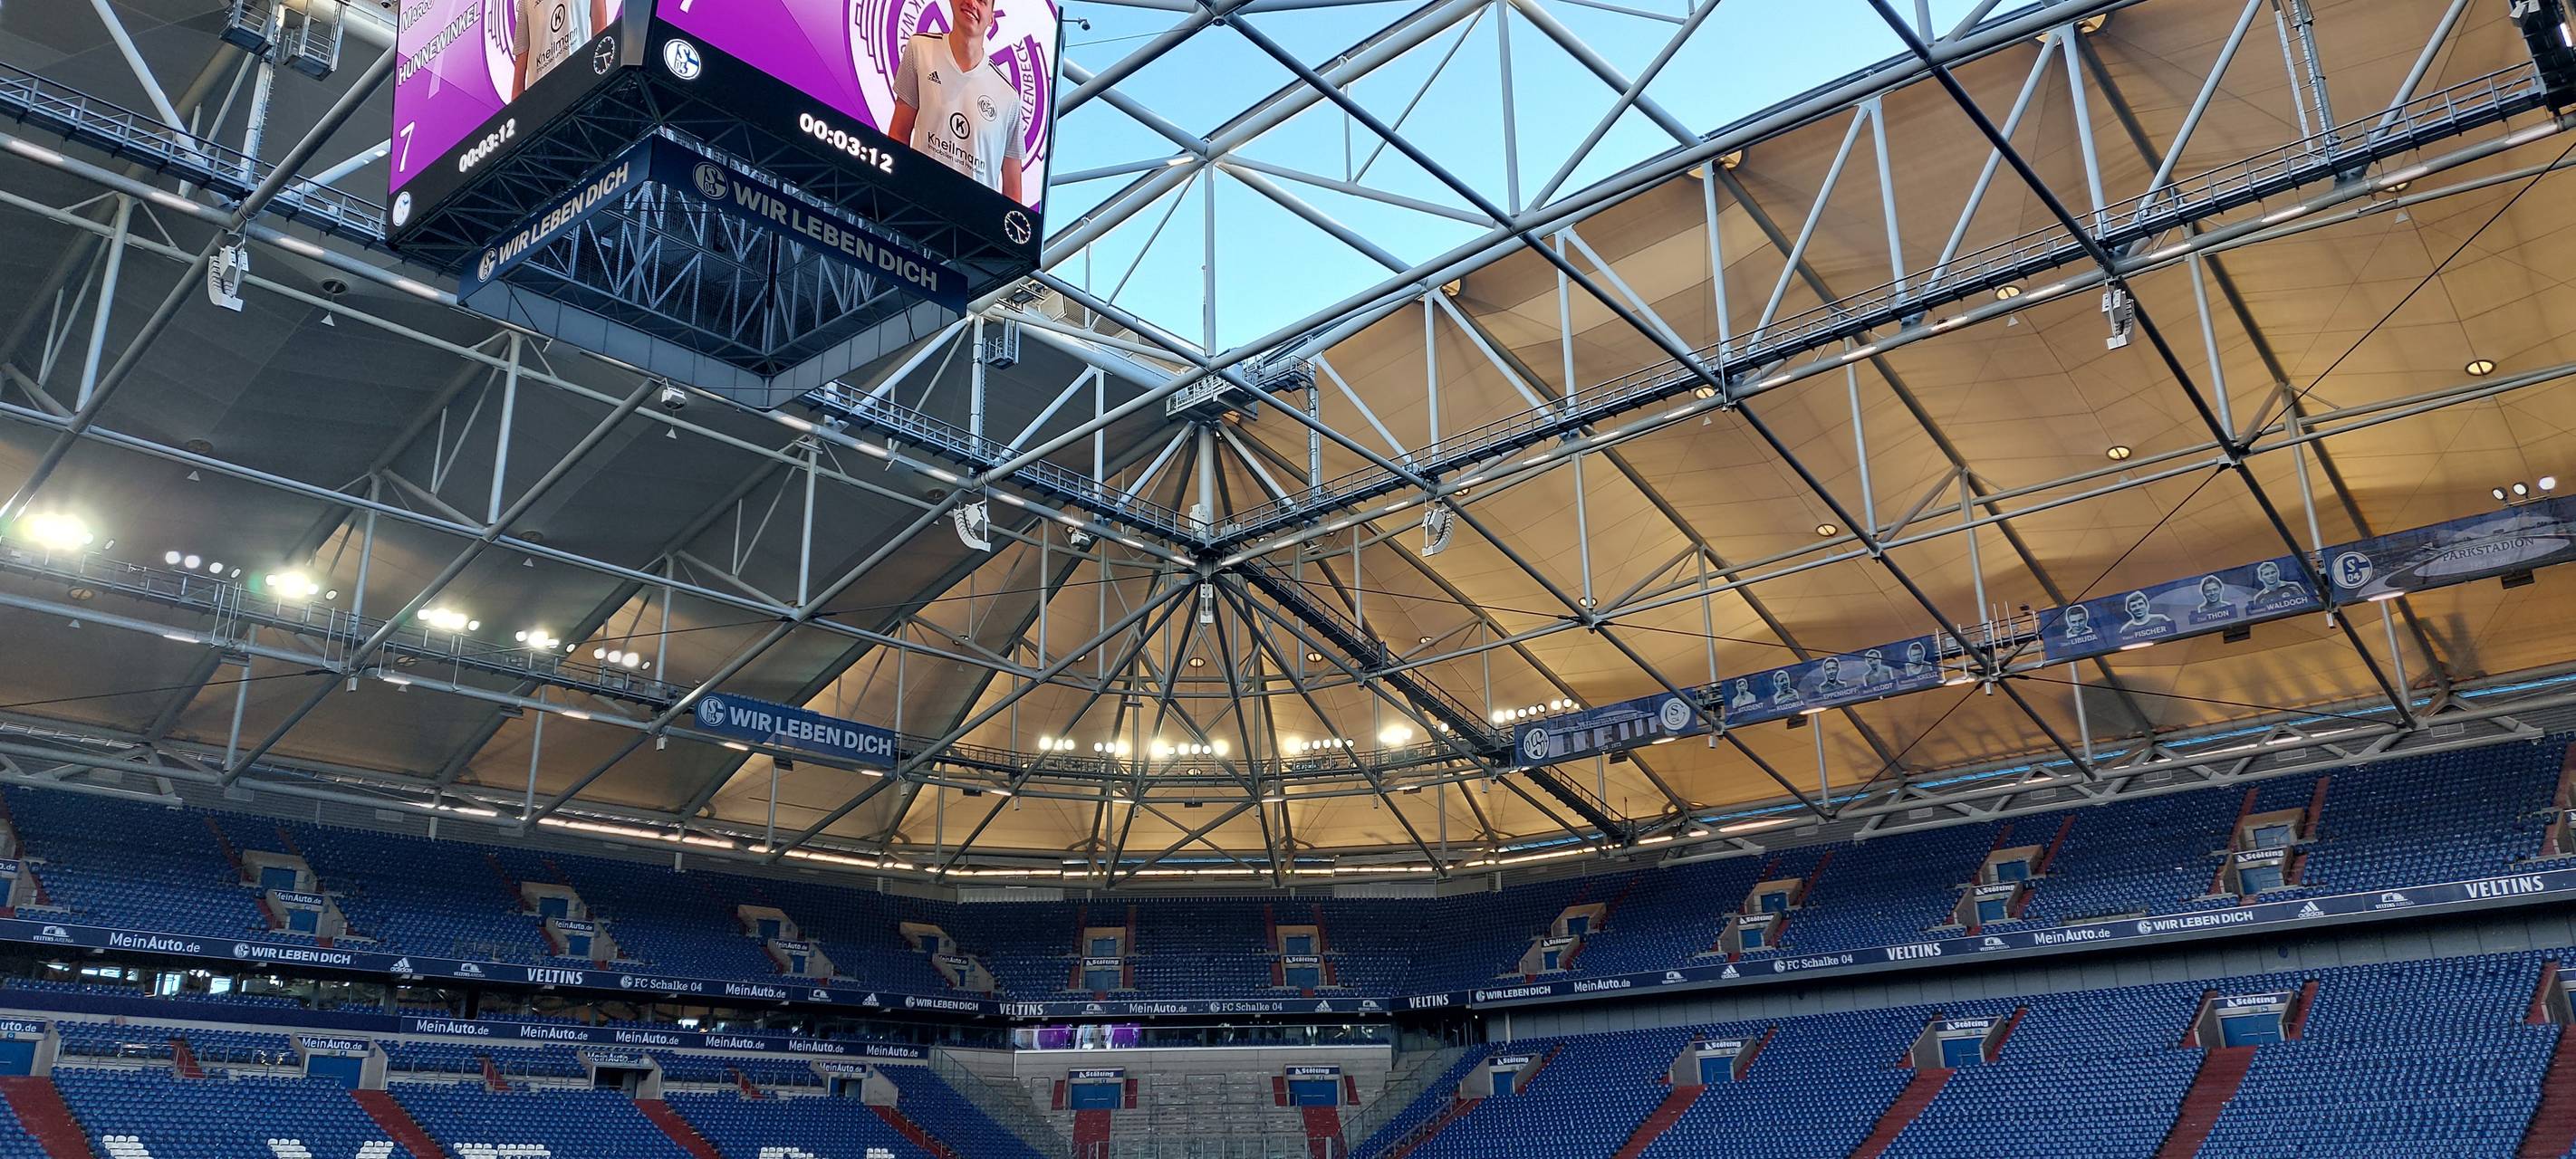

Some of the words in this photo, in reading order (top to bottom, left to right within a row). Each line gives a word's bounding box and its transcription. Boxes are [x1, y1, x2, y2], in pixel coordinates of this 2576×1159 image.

[399, 121, 415, 172] 7
[459, 118, 515, 173] 00:03:12
[799, 112, 893, 174] 00:03:12
[928, 131, 985, 170] Kneilmann
[498, 235, 529, 265] WIR
[529, 192, 583, 246] LEBEN
[584, 162, 630, 210] DICH
[733, 183, 788, 225] WIR
[792, 207, 875, 263] LEBEN
[878, 247, 938, 292] DICH
[2443, 537, 2535, 562] PARKSTADION
[2266, 596, 2309, 611] WALDOCH
[2206, 609, 2230, 621] THON
[2134, 626, 2167, 638] FISCHER
[2071, 635, 2099, 646] LIBUDA
[730, 706, 772, 733] WIR
[775, 716, 841, 748] LEBEN
[844, 731, 892, 756] DICH
[2465, 876, 2544, 899] VELTINS
[2152, 919, 2179, 931] WIR
[2180, 915, 2220, 928] LEBEN
[2221, 911, 2254, 924] DICH
[109, 933, 201, 953] MeinAuto.de
[2033, 928, 2110, 945] MeinAuto.de
[251, 946, 278, 959] WIR
[278, 949, 319, 963] LEBEN
[320, 952, 351, 965] DICH
[1886, 943, 1942, 961] VELTINS
[1786, 960, 1800, 971] FC
[1801, 956, 1840, 969] Schalke
[1841, 953, 1853, 965] 04
[527, 967, 583, 985] VELTINS
[635, 977, 648, 988] FC
[649, 977, 689, 991] Schalke
[690, 980, 703, 991] 04
[725, 983, 786, 999] MeinAuto.de
[1485, 991, 1502, 1000] WIR
[1502, 988, 1529, 999] LEBEN
[1529, 985, 1552, 996] DICH
[1573, 979, 1631, 993] MeinAuto.de
[916, 999, 932, 1008] WIR
[932, 1000, 957, 1010] LEBEN
[957, 1001, 979, 1011] DICH
[1129, 1002, 1187, 1014] MeinAuto.de
[1222, 1002, 1235, 1011] FC
[1235, 1001, 1270, 1011] Schalke
[1271, 1002, 1283, 1011] 04
[1408, 994, 1449, 1009] VELTINS
[2236, 996, 2277, 1006] Stölting
[1000, 1002, 1043, 1017] VELTINS
[416, 1020, 489, 1036] MeinAuto.de
[520, 1025, 589, 1041] MeinAuto.de
[302, 1037, 363, 1051] MeinAuto.de
[615, 1030, 679, 1047] MeinAuto.de
[706, 1036, 765, 1050] MeinAuto.de
[788, 1039, 844, 1054] MeinAuto.de
[866, 1044, 918, 1058] MeinAuto.de
